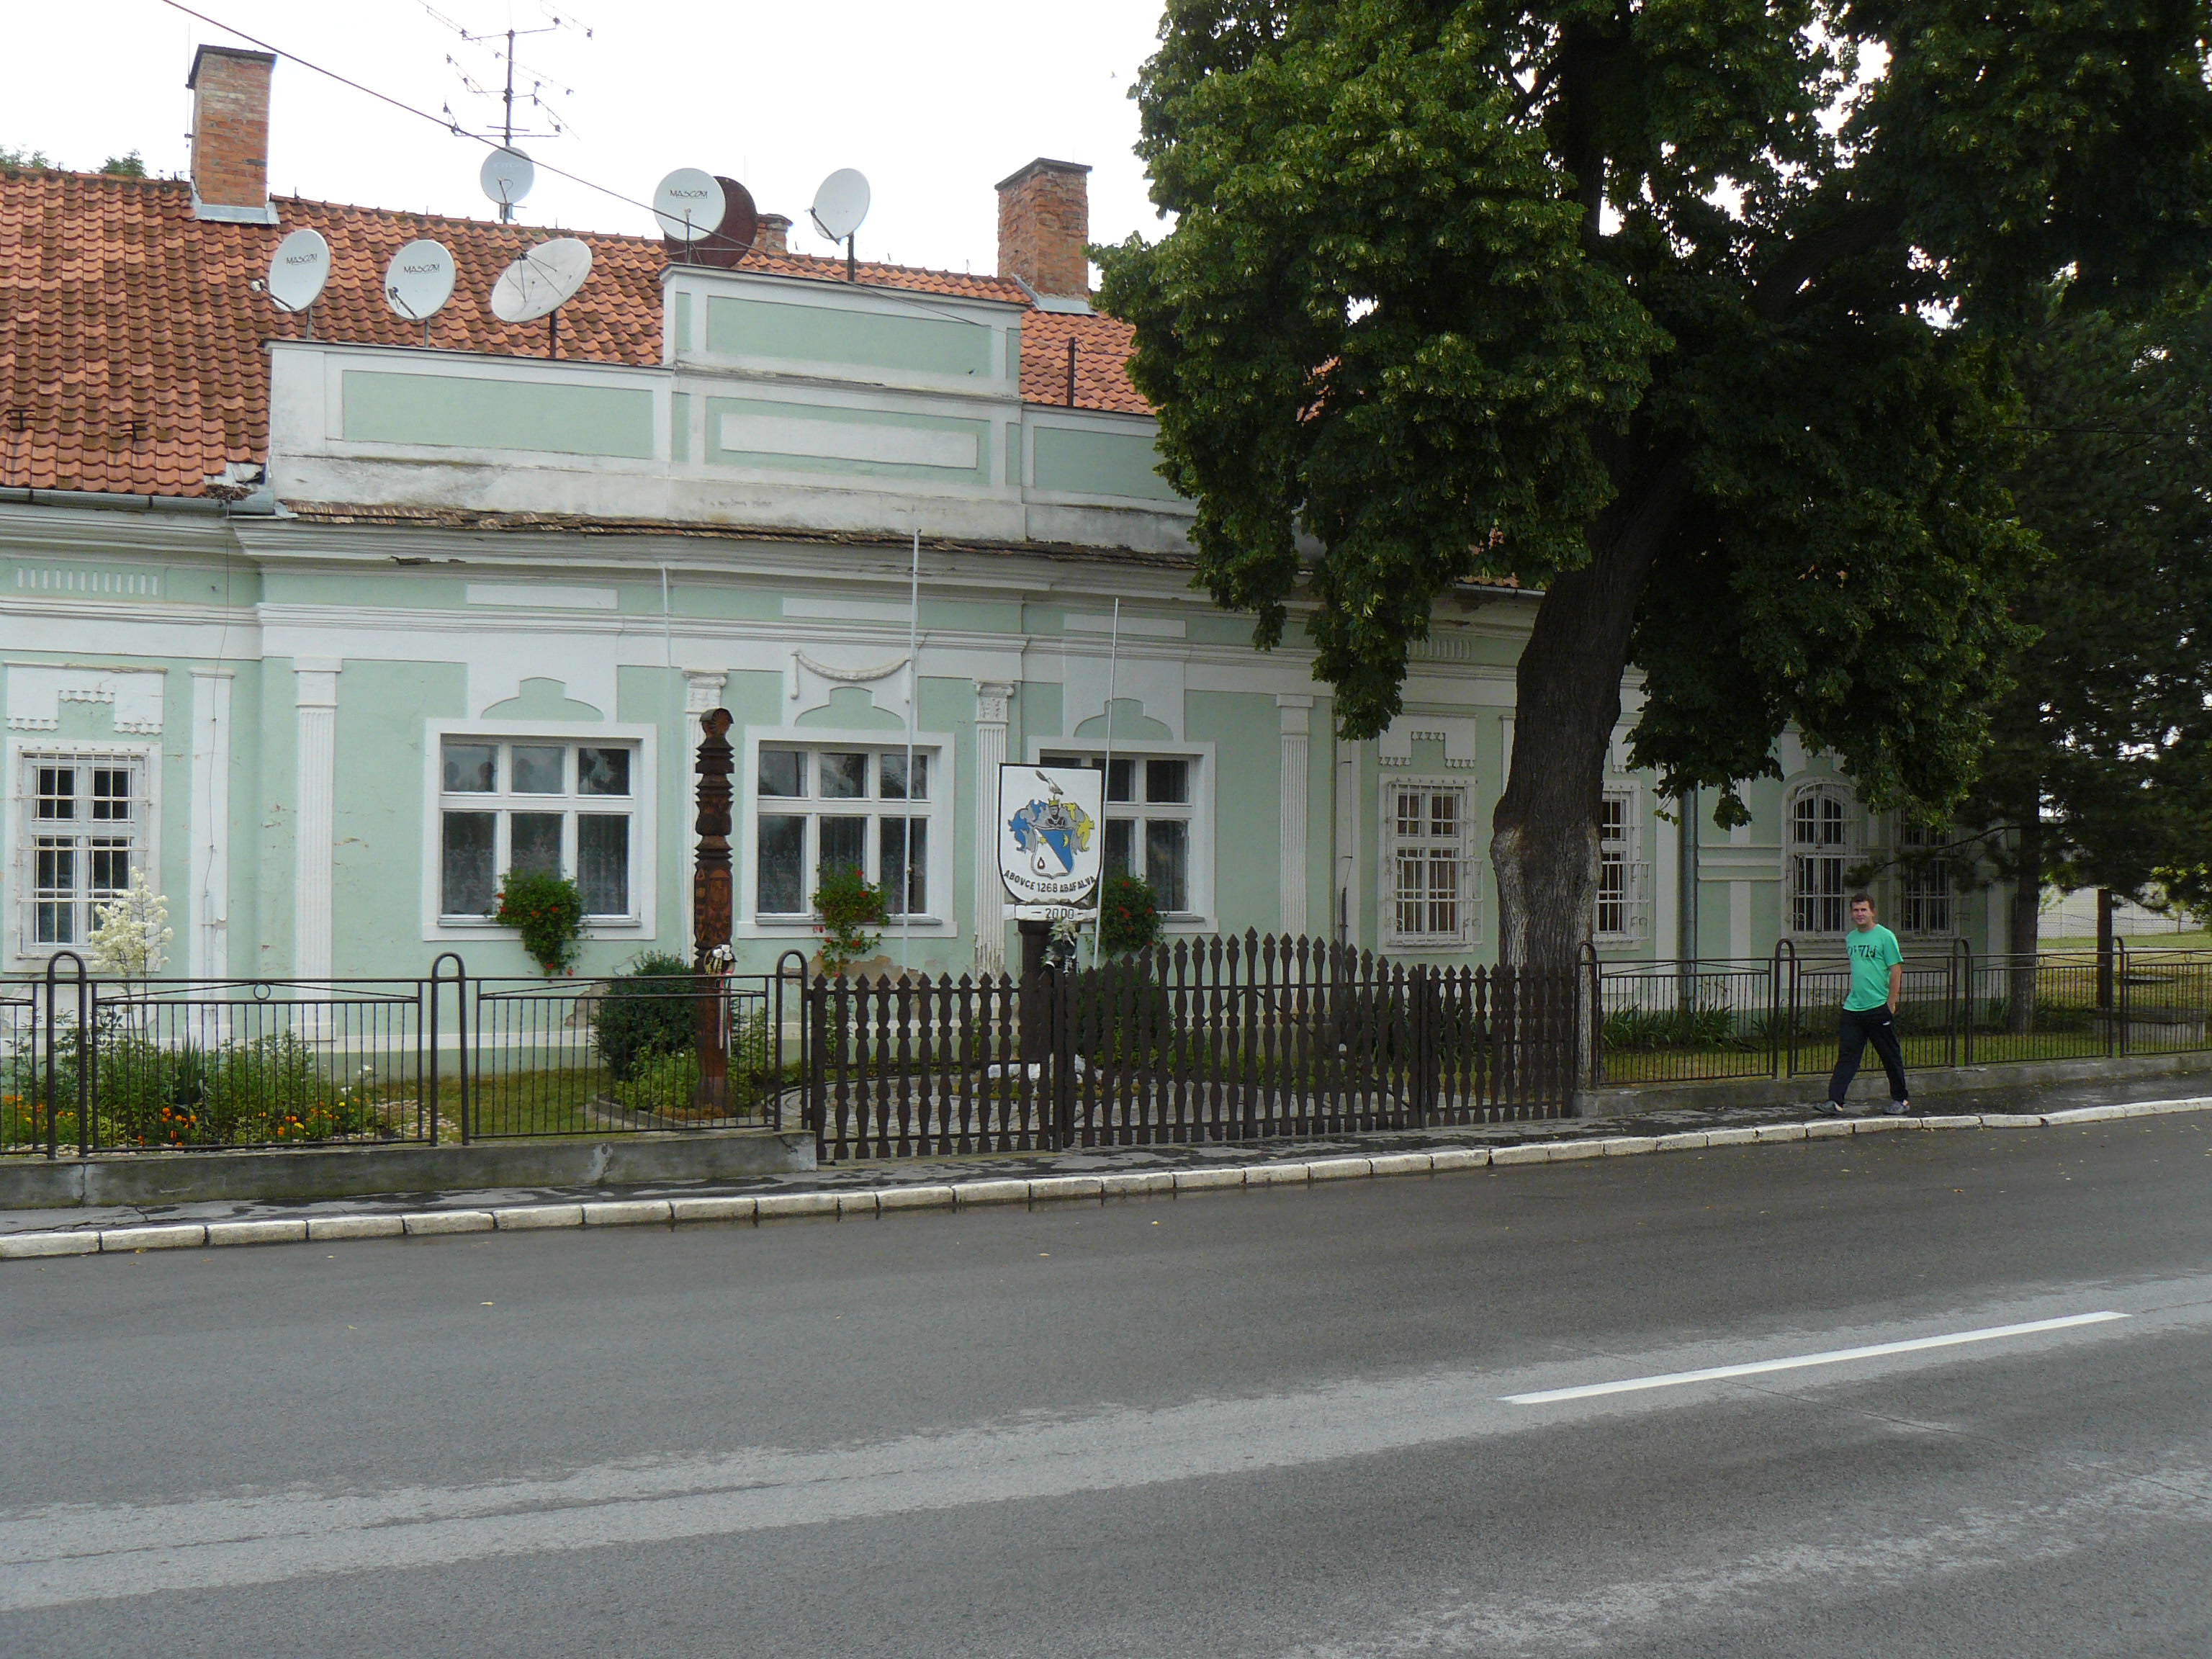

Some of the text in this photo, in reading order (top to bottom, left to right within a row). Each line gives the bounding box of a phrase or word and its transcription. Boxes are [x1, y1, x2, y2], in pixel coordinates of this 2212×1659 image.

[669, 189, 708, 199] MASCOM
[404, 263, 440, 274] MASCOM
[1004, 869, 1095, 893] ABOVCE 1268 ABAFALVA
